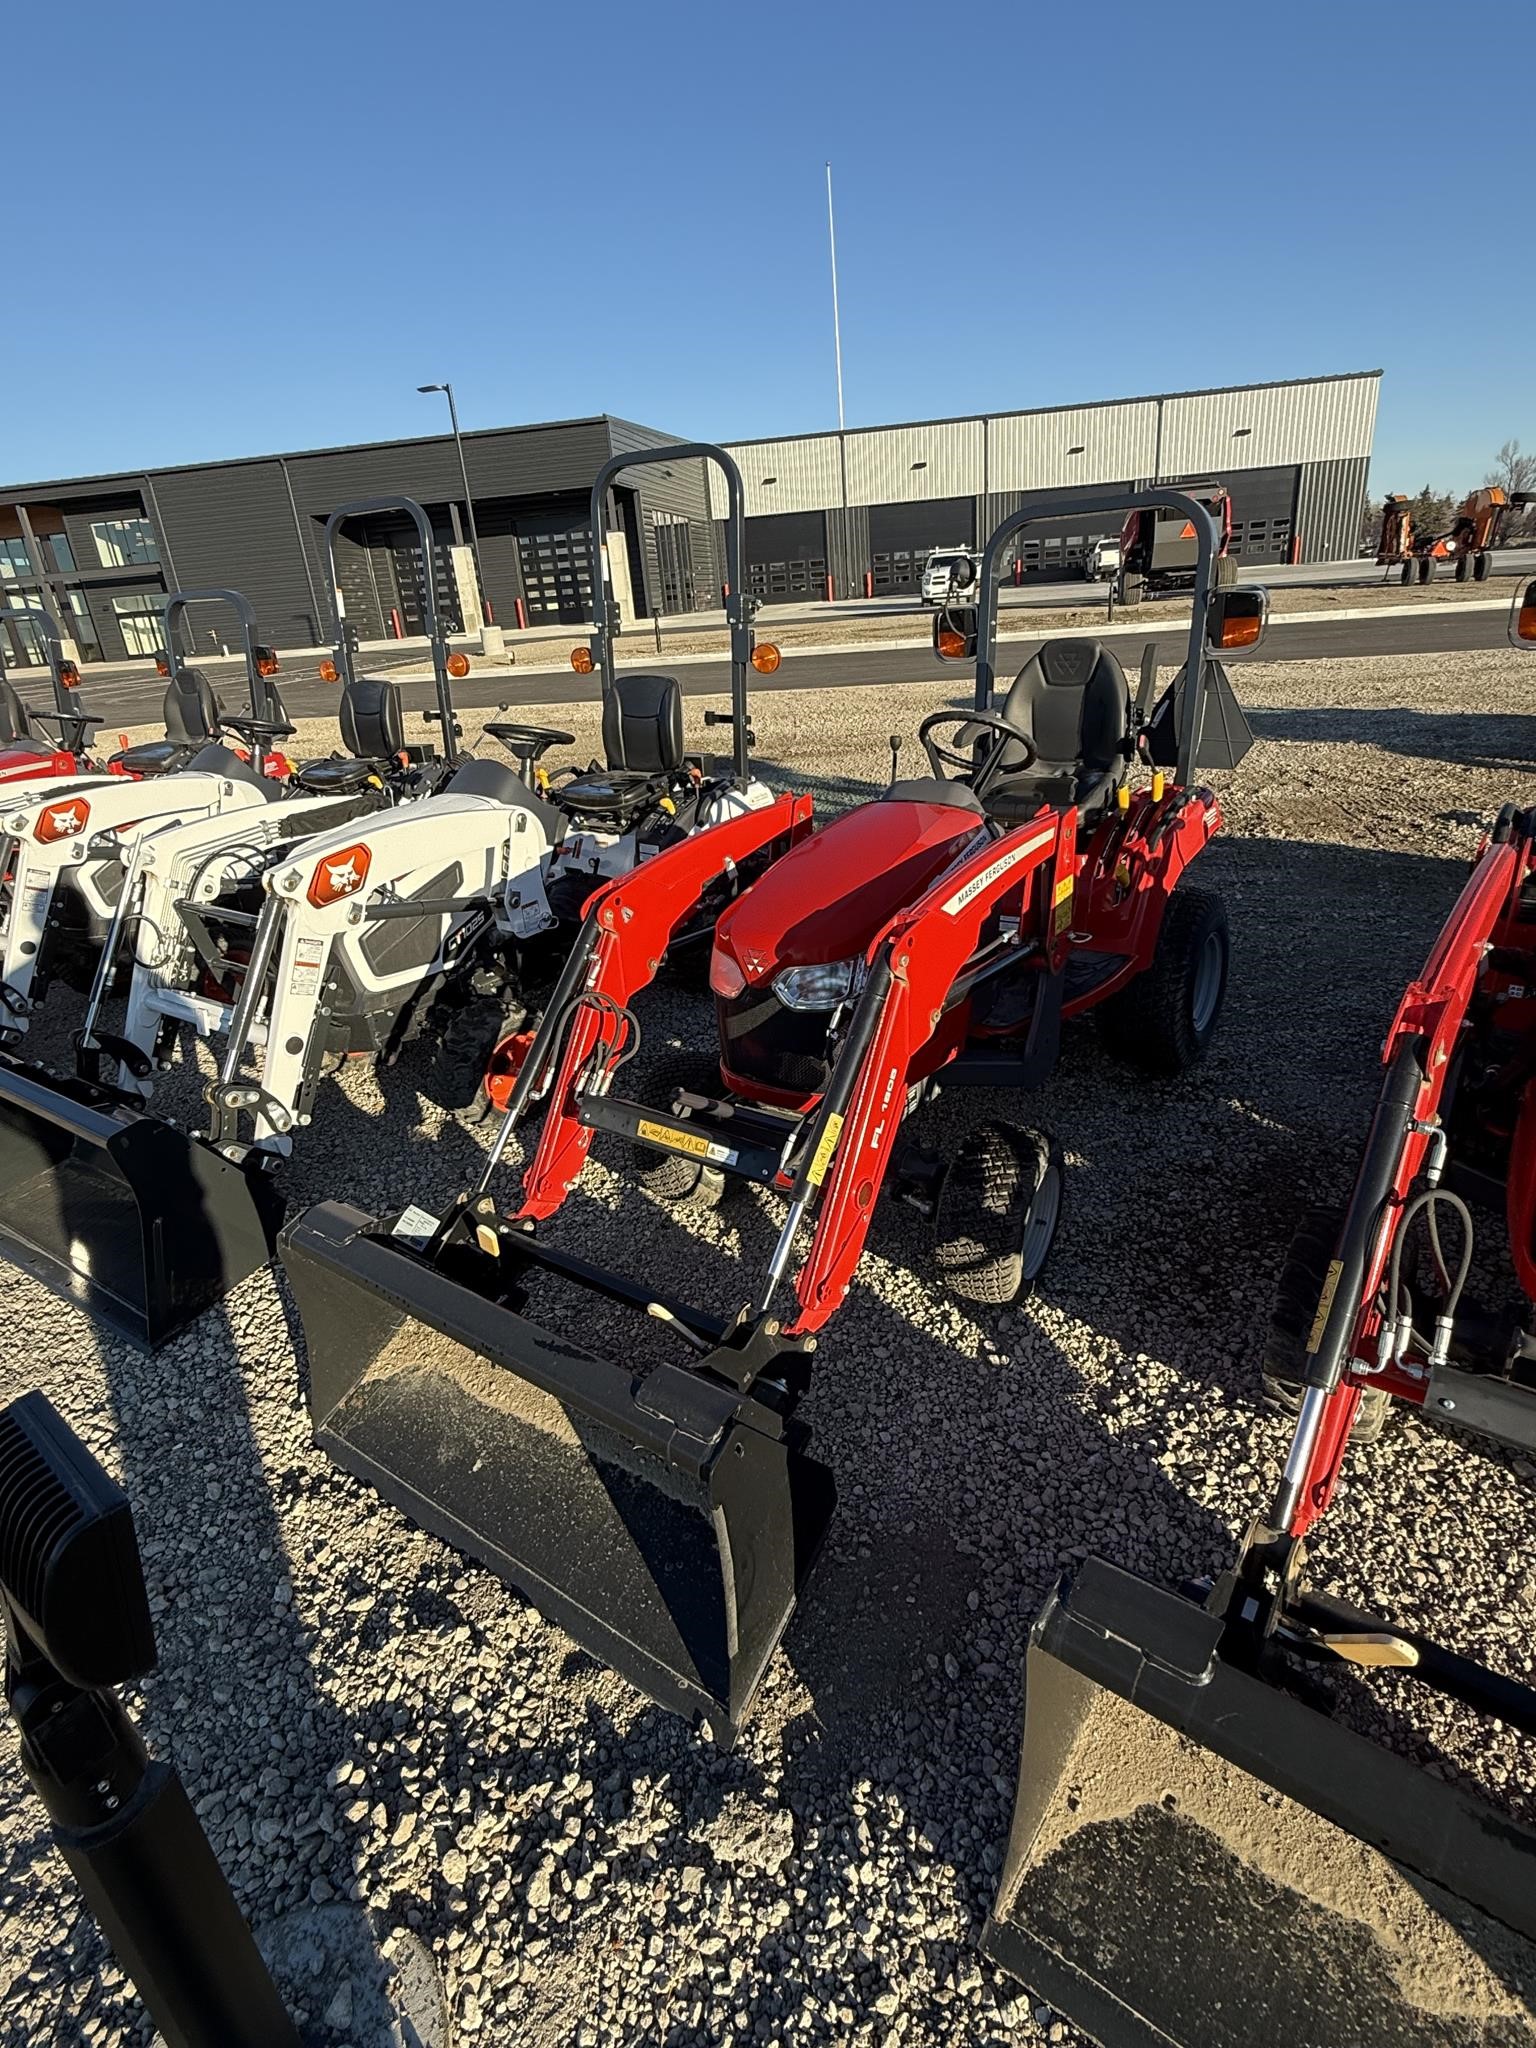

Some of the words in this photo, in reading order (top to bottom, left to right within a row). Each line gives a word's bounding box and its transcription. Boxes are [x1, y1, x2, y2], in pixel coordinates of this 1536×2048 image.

[958, 876, 984, 906] MASSEY
[985, 853, 1016, 882] FERGUSON
[448, 911, 485, 951] CT1025
[870, 1120, 884, 1149] FL
